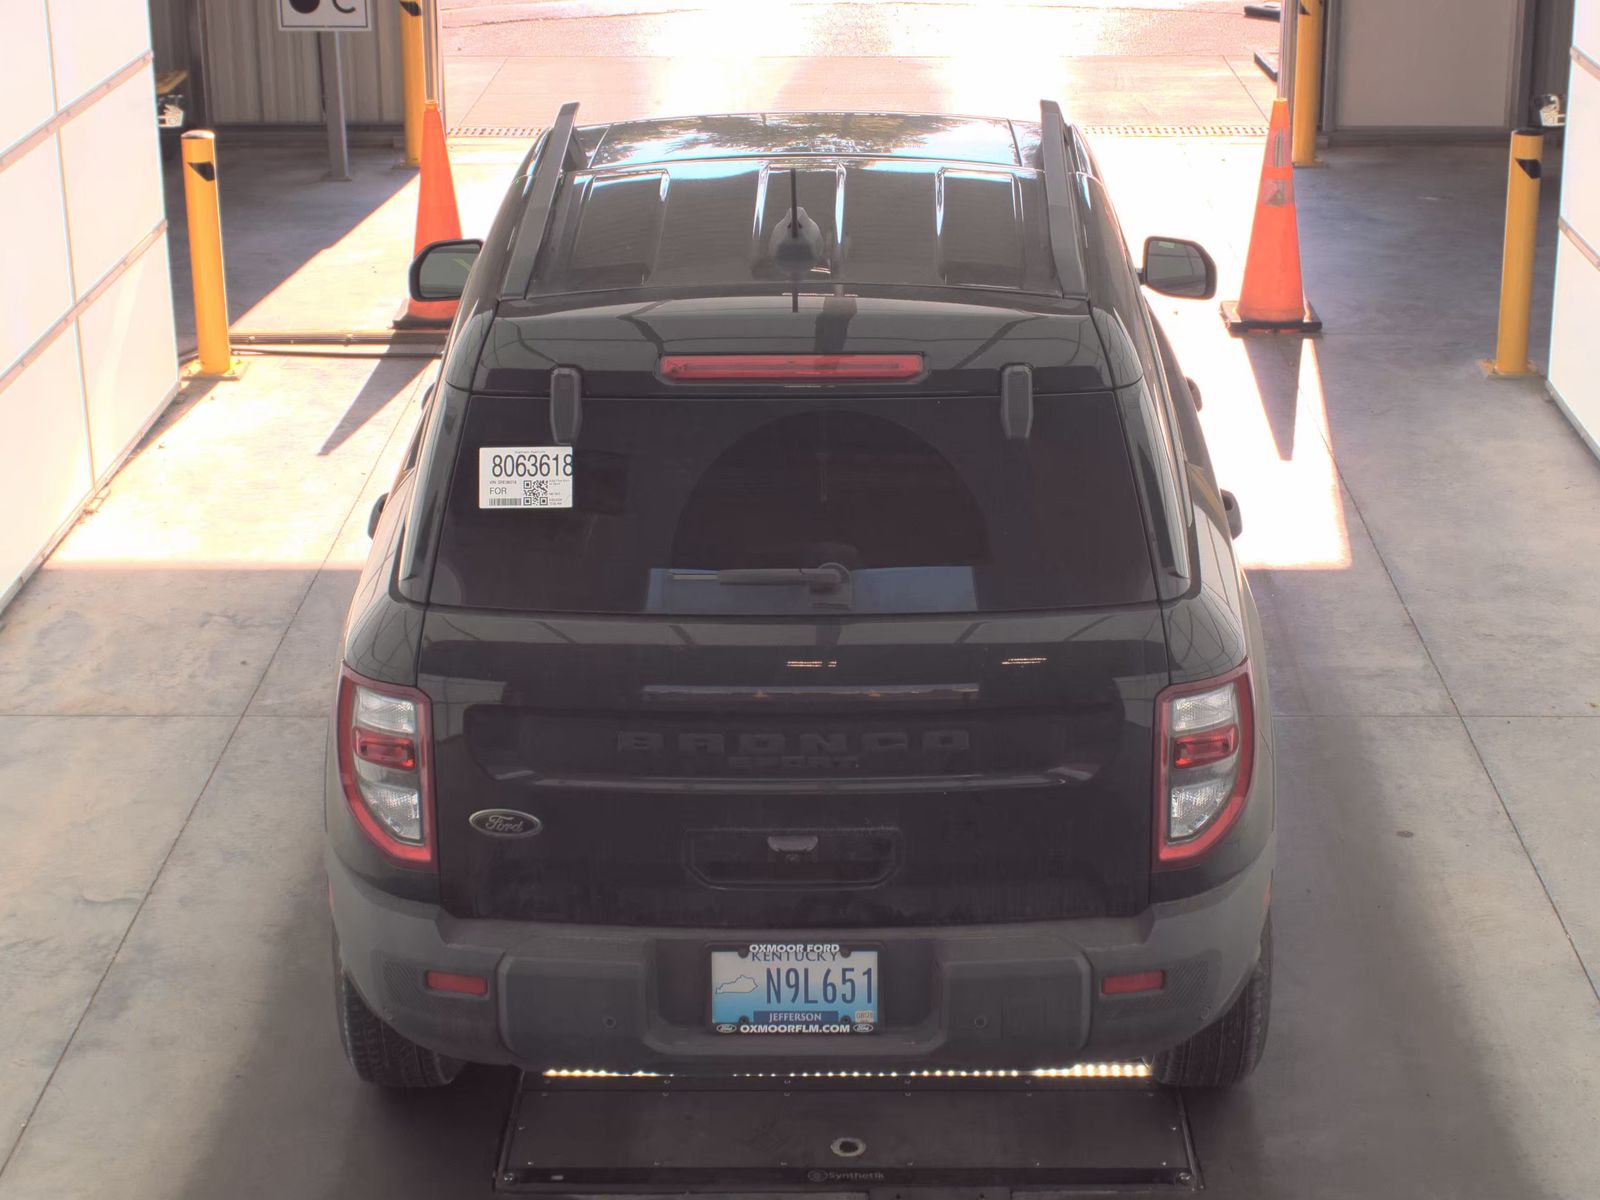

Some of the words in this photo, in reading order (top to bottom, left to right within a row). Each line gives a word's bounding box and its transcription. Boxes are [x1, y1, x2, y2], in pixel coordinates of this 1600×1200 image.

[492, 454, 573, 477] 8063618
[617, 730, 970, 753] BRONCO
[486, 815, 524, 832] Ford
[749, 944, 804, 952] OXMOOR
[806, 944, 840, 952] FORD
[751, 951, 838, 962] KENTUCKY
[766, 967, 872, 1004] N9L651
[769, 1012, 822, 1022] JEFFERSON
[740, 1024, 850, 1033] OXMOORFLM.COM
